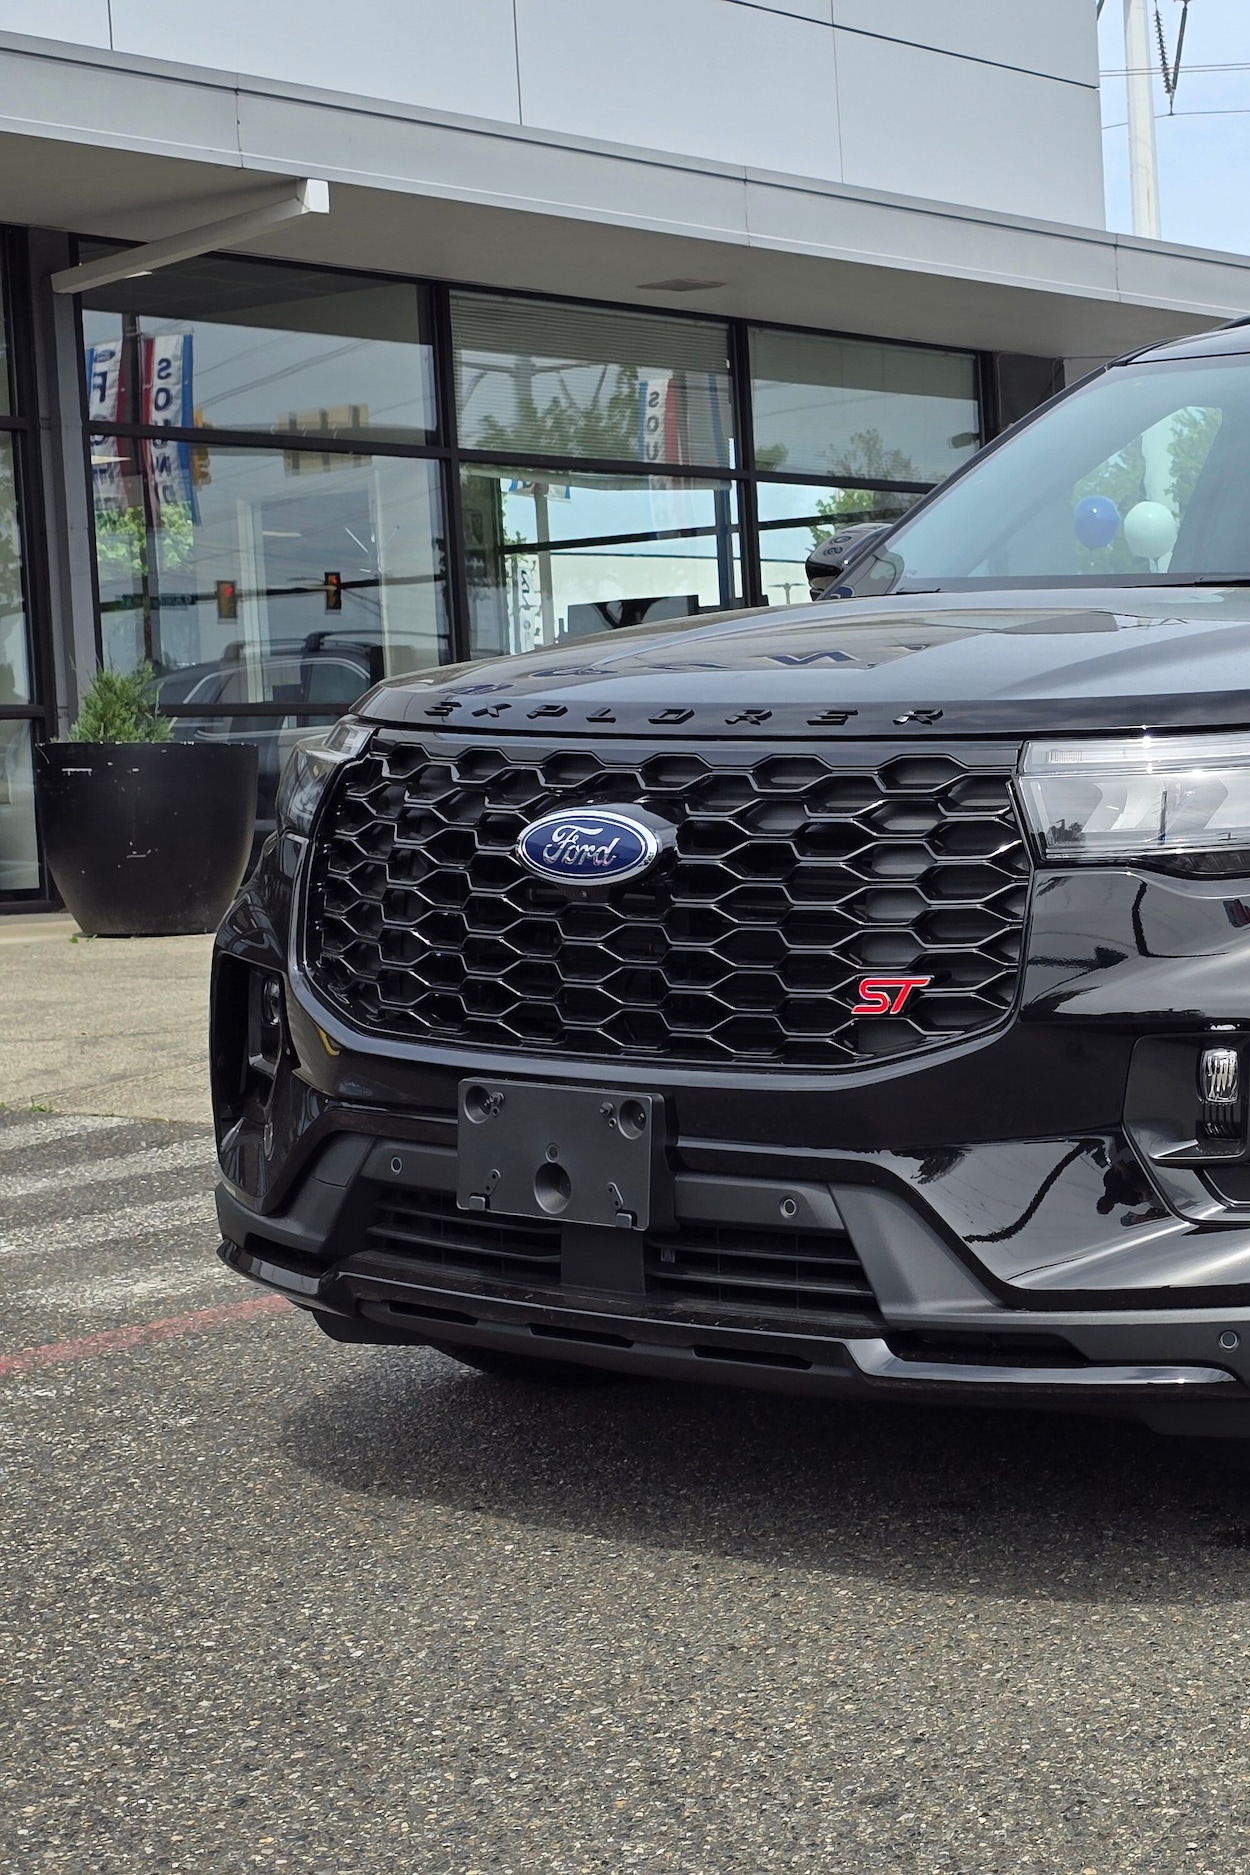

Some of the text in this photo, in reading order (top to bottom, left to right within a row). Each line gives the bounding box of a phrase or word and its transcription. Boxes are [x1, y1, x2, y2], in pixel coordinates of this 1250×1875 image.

[423, 700, 944, 727] EXPLORER
[542, 823, 622, 868] Ford
[851, 975, 935, 1016] ST
